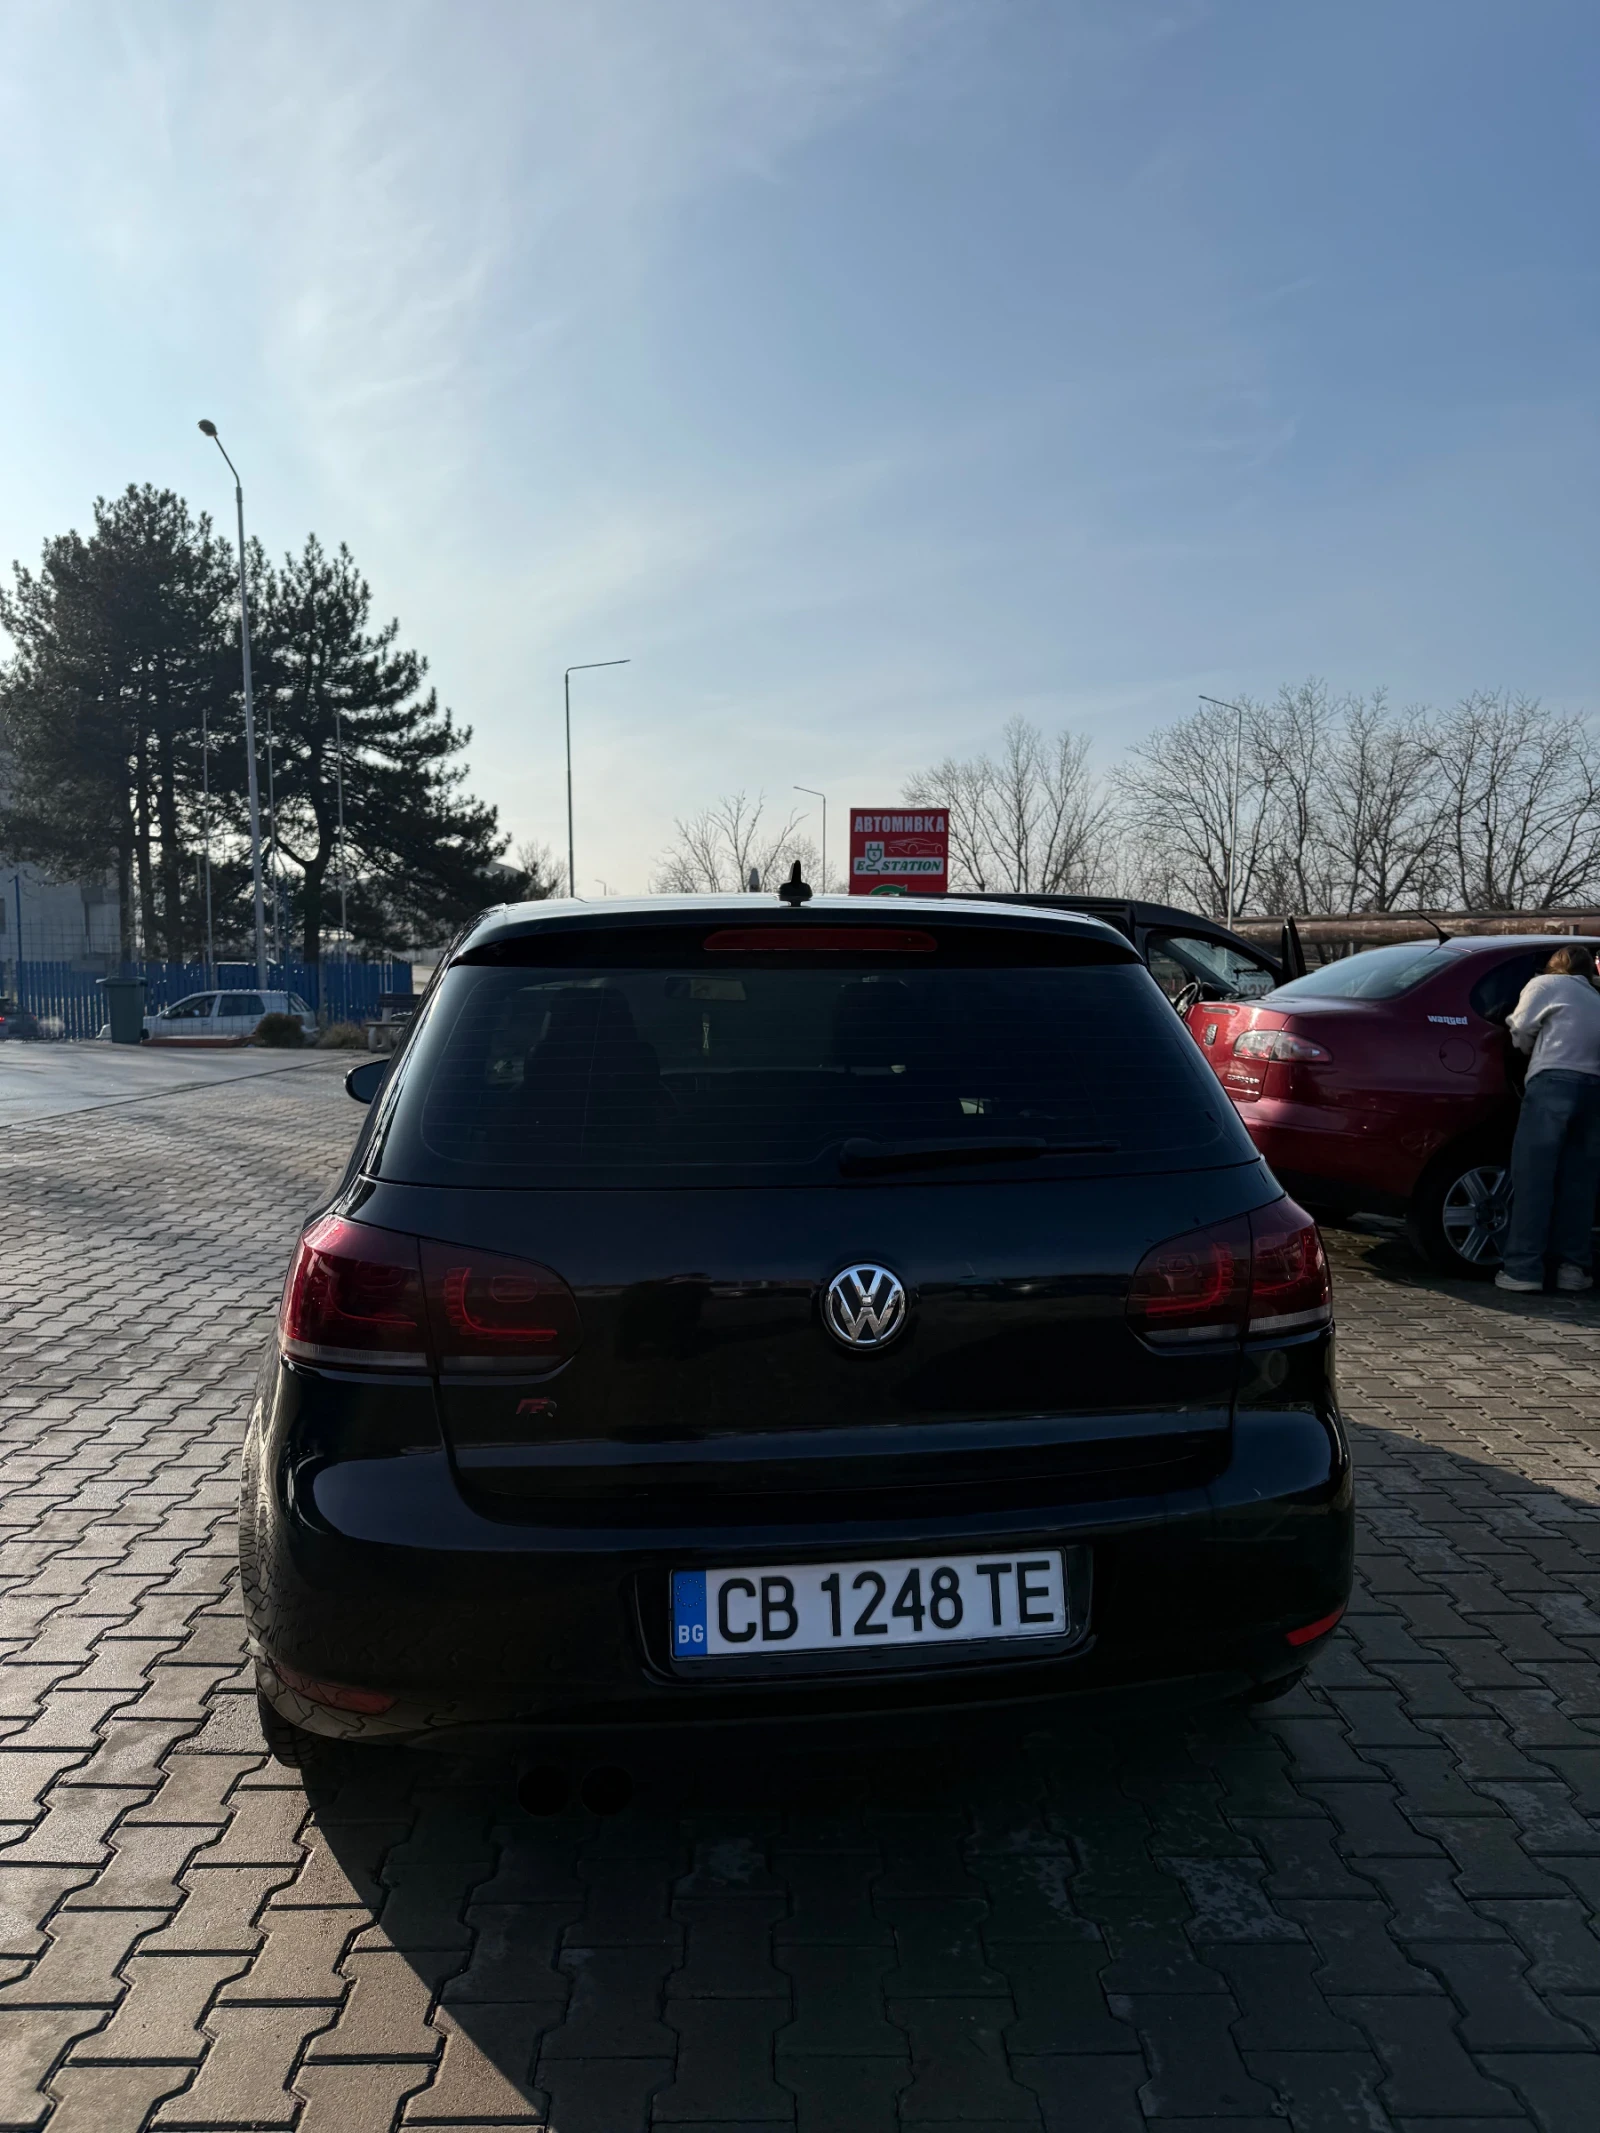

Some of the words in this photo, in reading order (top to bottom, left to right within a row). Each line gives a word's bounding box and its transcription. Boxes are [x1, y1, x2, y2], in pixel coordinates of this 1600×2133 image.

[854, 816, 945, 832] АВТОМИВКА
[881, 860, 942, 871] STATION
[1427, 1014, 1468, 1025] wanted
[829, 1265, 902, 1343] VW
[717, 1576, 799, 1643] CB
[821, 1566, 964, 1637] 1248
[976, 1561, 1054, 1626] TE
[678, 1625, 704, 1644] BG
